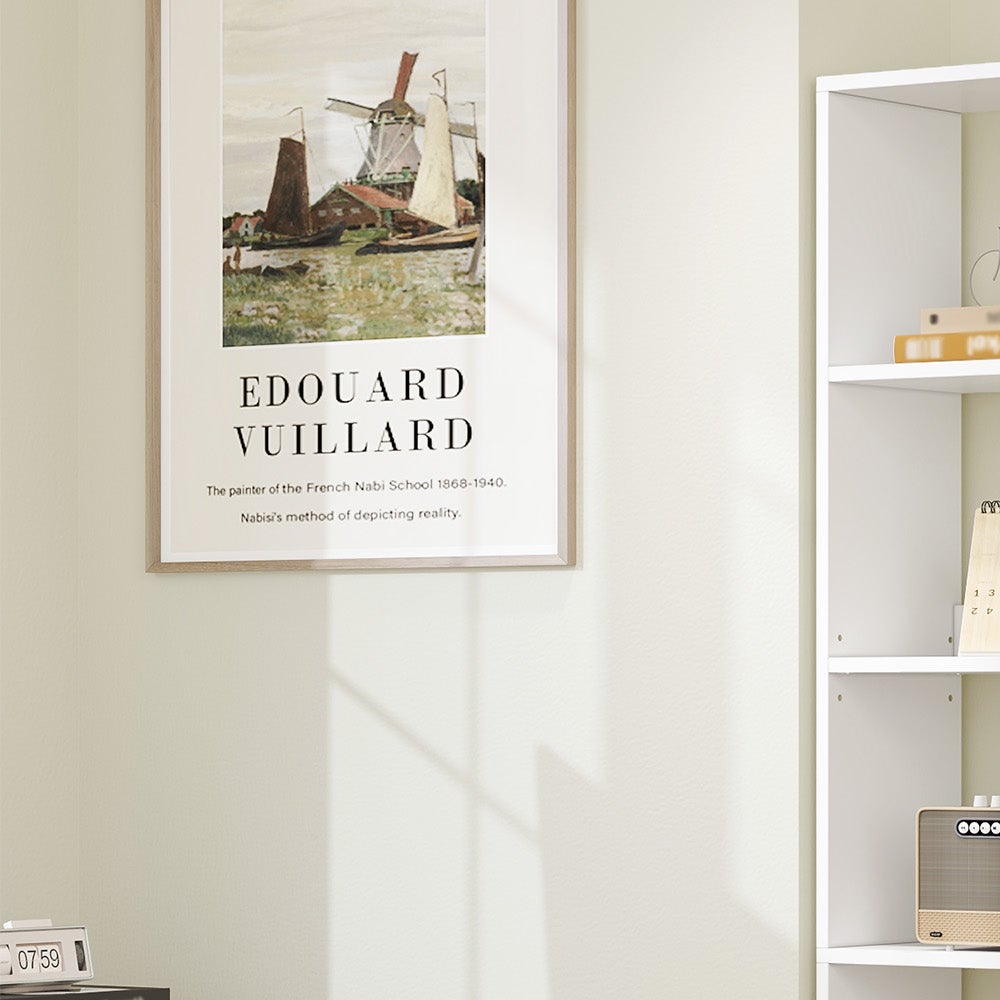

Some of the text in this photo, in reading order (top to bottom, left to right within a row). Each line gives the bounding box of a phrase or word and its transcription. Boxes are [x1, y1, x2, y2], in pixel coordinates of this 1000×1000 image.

[239, 366, 465, 408] EDOUARD
[233, 417, 473, 457] VUILLARD
[206, 477, 507, 498] The painter of the French Nabi School 1868-1940.
[241, 507, 462, 523] Nabisi's method of depicting reality.
